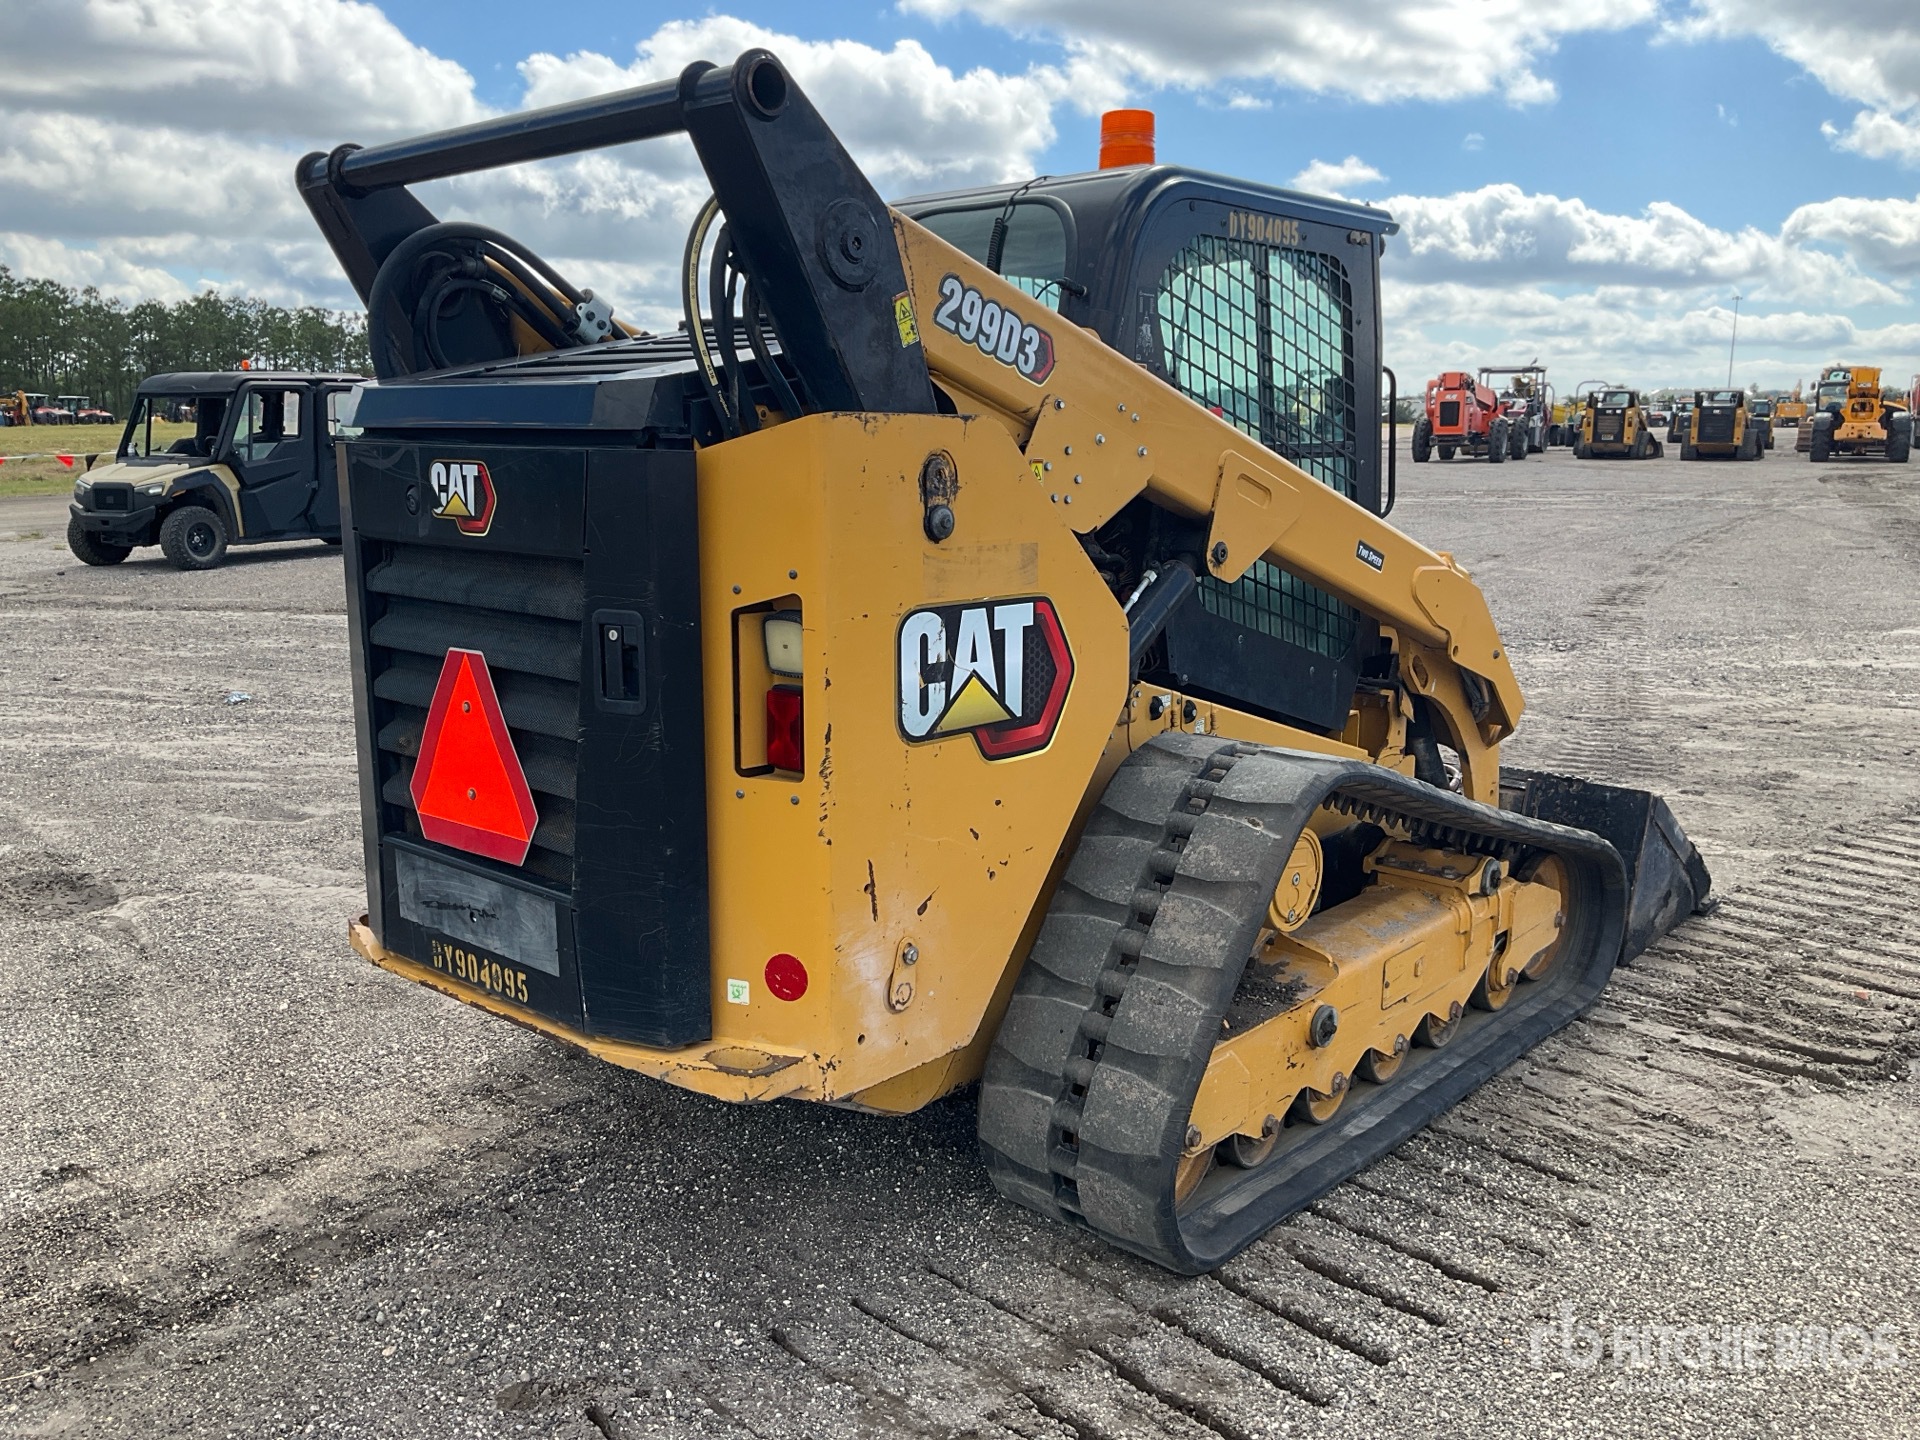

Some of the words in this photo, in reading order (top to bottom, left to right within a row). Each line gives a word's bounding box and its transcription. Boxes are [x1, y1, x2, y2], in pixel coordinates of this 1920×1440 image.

[1229, 211, 1299, 246] DY904095
[936, 277, 1040, 375] 299D3
[430, 462, 479, 517] CAT
[901, 602, 1034, 737] CAT
[432, 939, 528, 1003] DY904095
